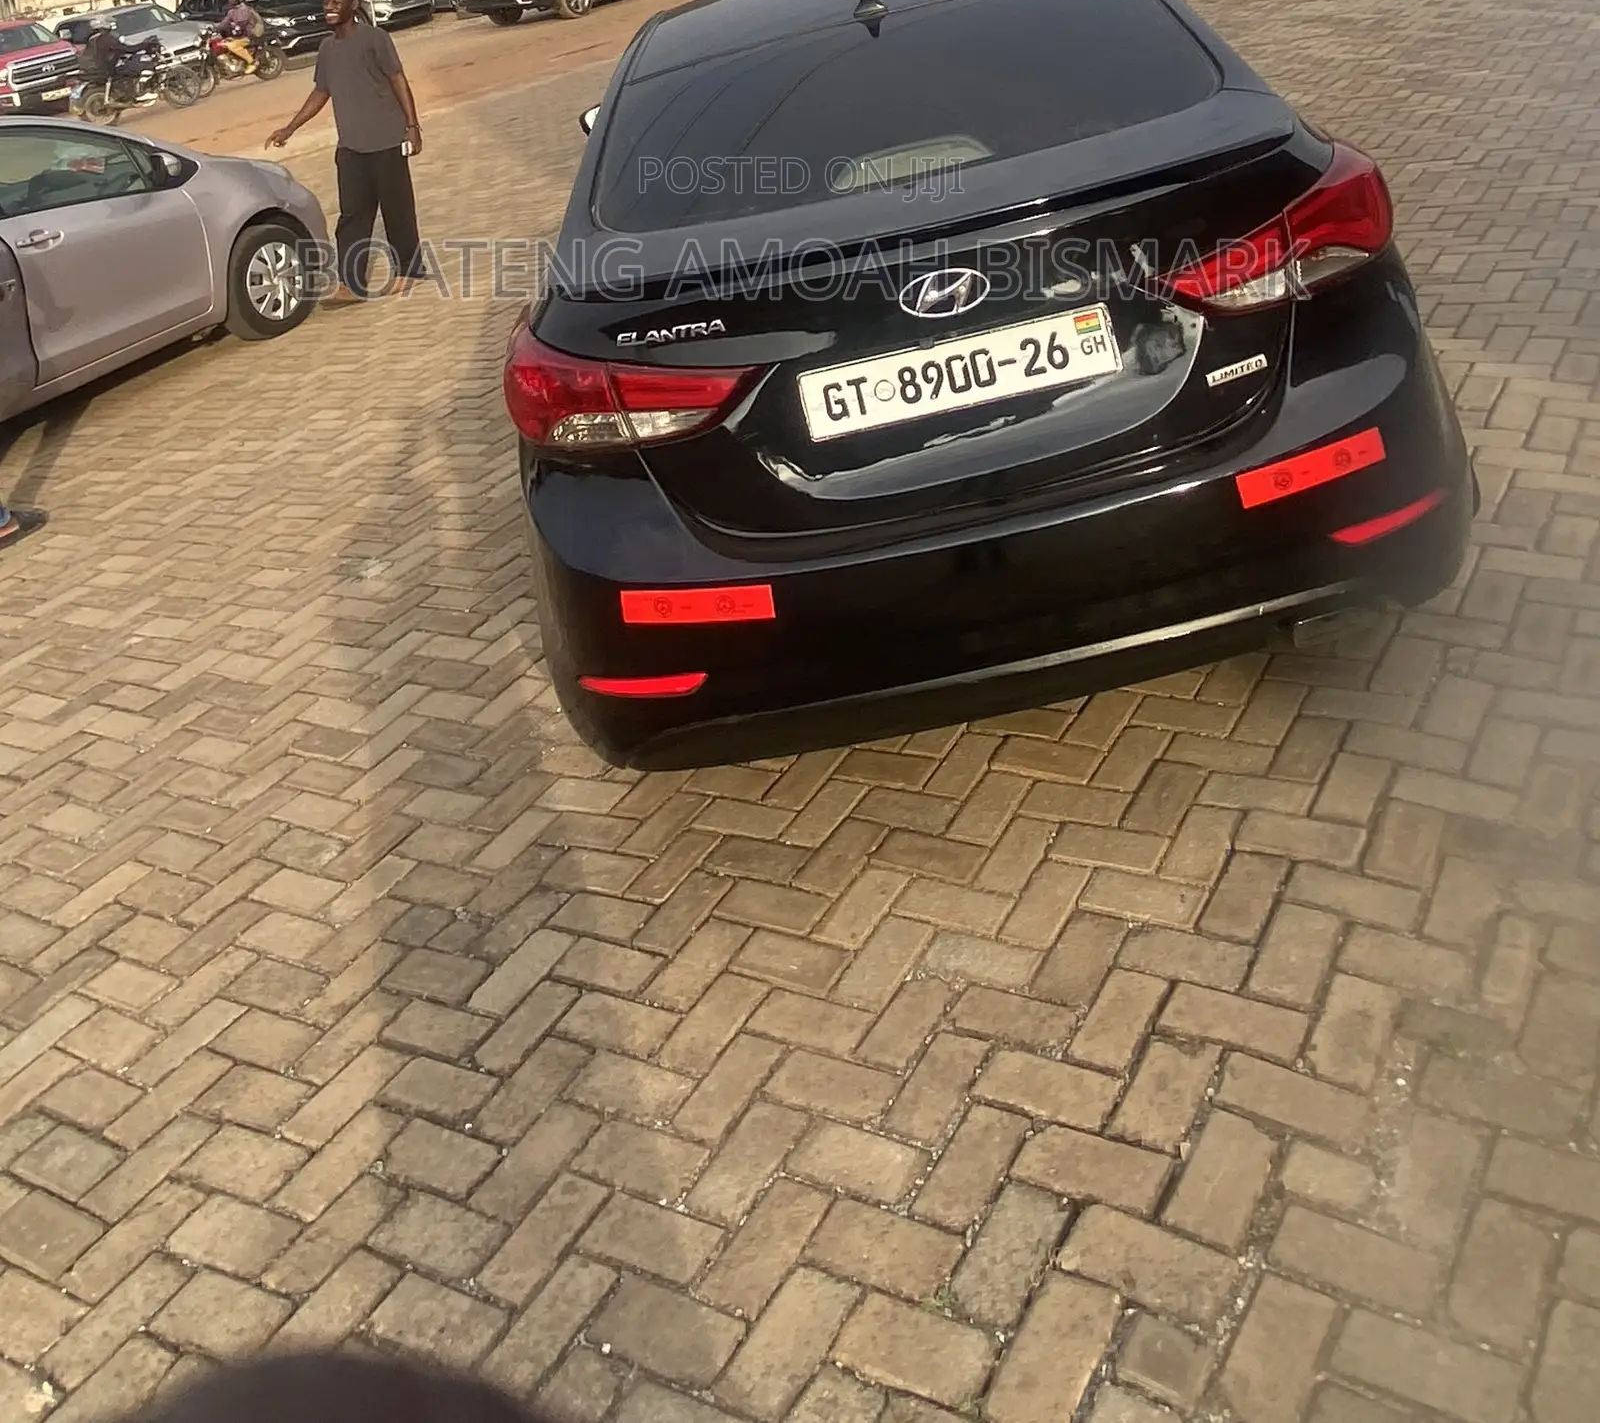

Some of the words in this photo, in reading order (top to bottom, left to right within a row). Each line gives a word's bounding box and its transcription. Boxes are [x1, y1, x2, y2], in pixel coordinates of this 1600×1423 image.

[617, 319, 726, 346] ELANTRA
[1080, 335, 1107, 356] GH
[823, 376, 868, 422] GT
[898, 332, 1069, 405] 8900-26
